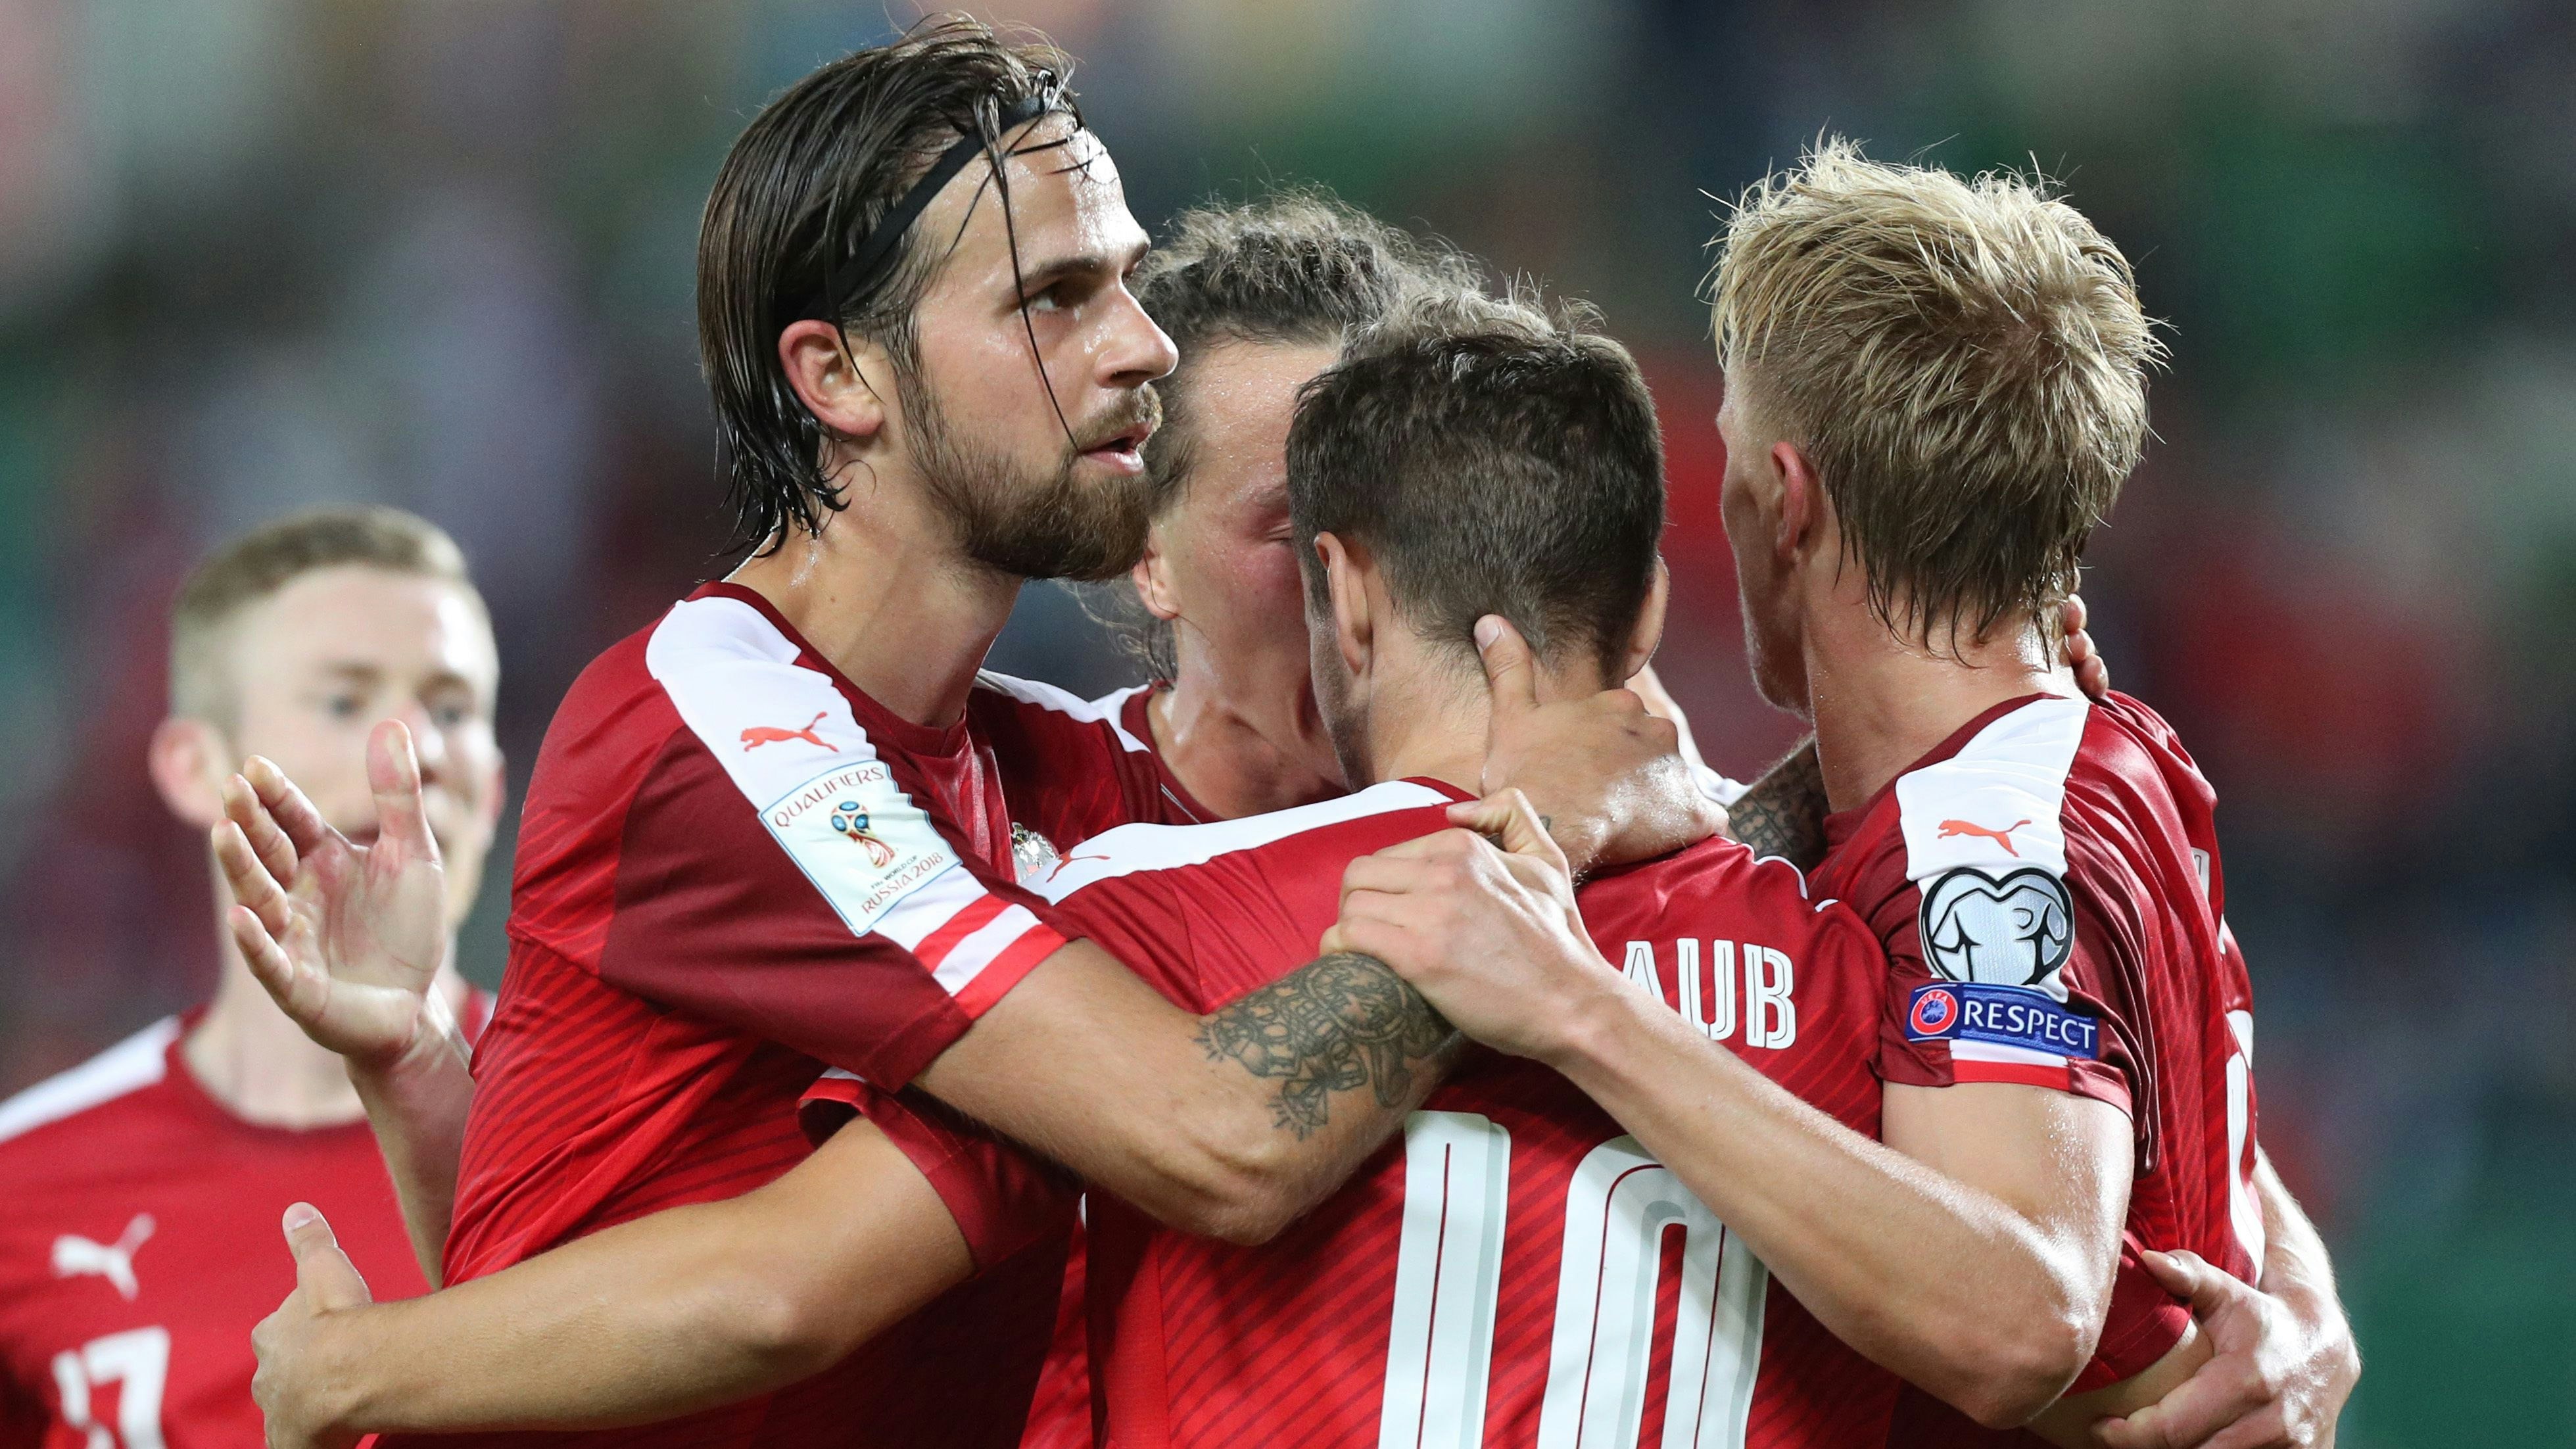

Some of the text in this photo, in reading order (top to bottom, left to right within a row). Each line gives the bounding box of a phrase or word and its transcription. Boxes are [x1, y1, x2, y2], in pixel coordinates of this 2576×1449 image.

[775, 767, 885, 827] QUALIFIERS
[861, 852, 943, 915] RUSSIA 2018
[884, 863, 907, 880] WORLD
[906, 855, 917, 865] CUP
[1920, 992, 1948, 1004] UEFA
[1964, 1000, 2096, 1049] RESPECT
[1377, 1110, 1769, 1449] 10
[52, 1324, 172, 1449] 17
